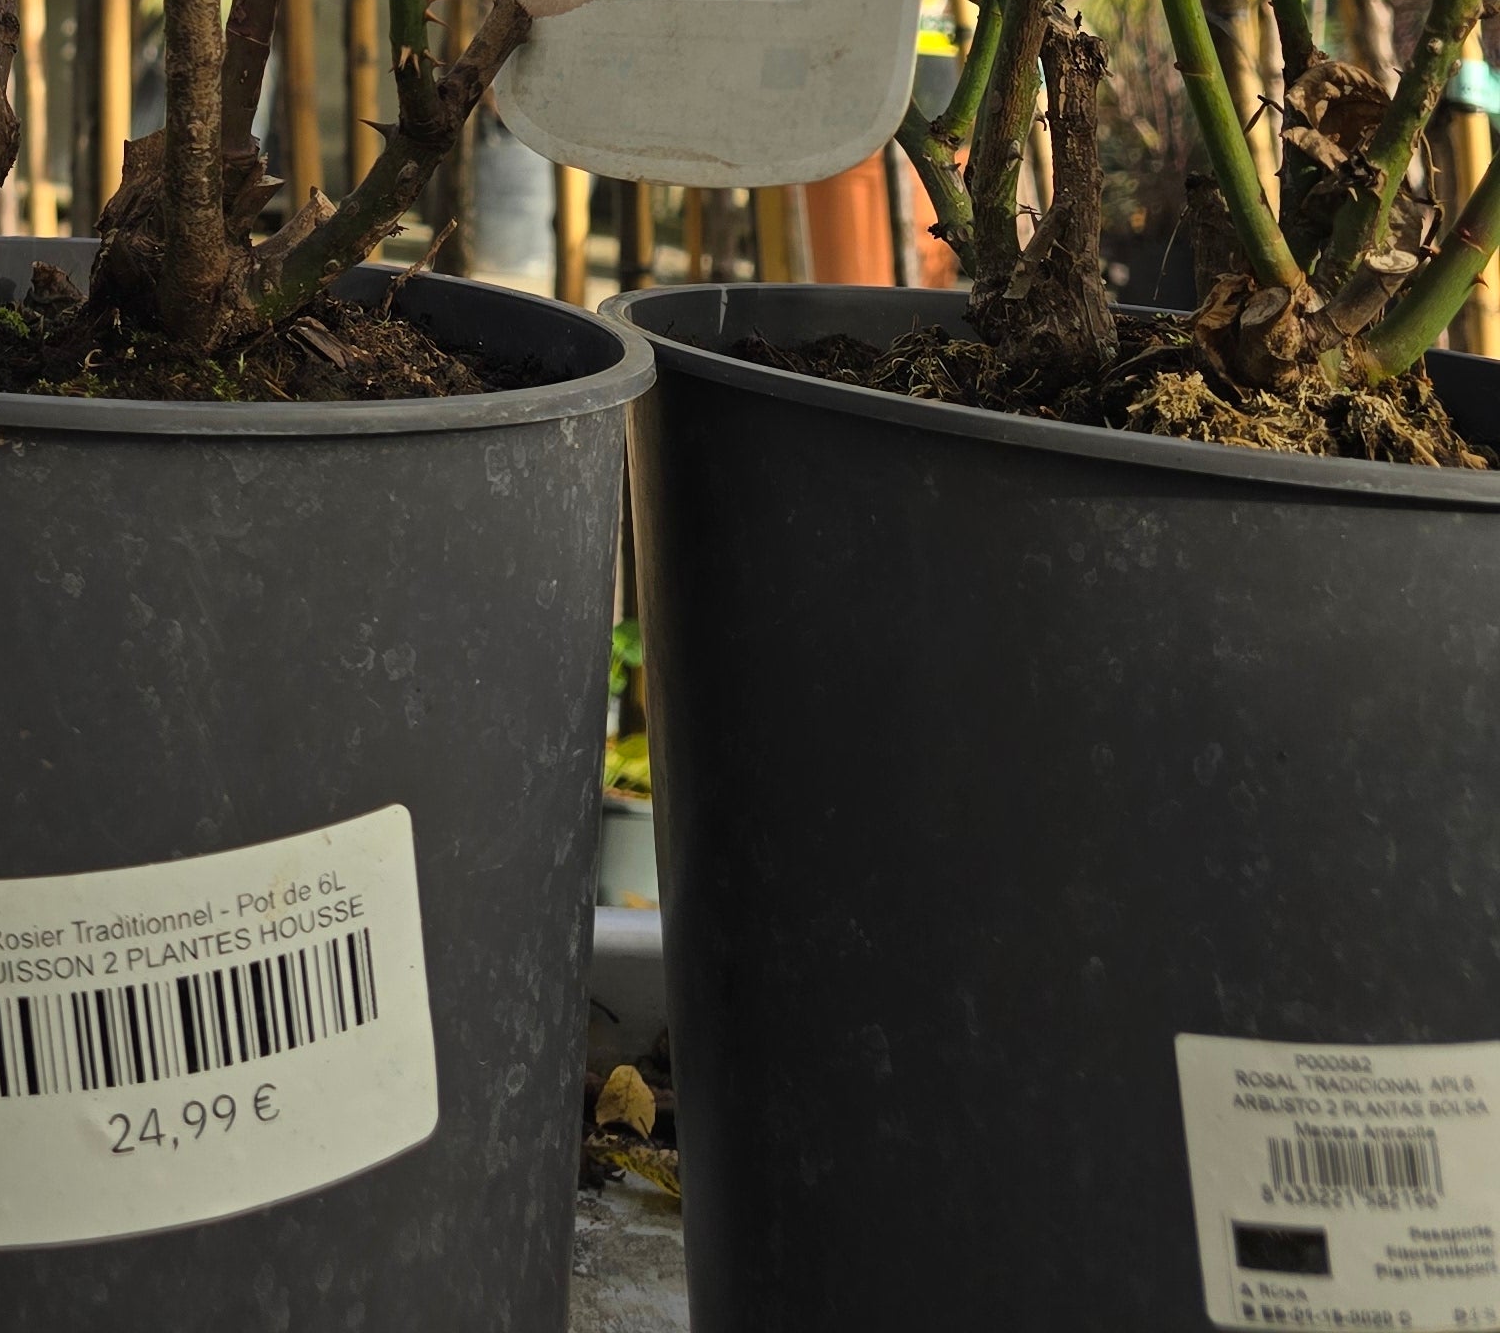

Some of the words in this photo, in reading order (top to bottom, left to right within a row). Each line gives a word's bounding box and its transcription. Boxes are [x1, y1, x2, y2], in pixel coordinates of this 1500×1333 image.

[72, 901, 213, 944] Traditionnel
[237, 889, 277, 917] Pot
[284, 882, 312, 906] de
[319, 871, 346, 894] 6L
[103, 950, 120, 975] 2
[128, 928, 252, 971] PLANTES
[260, 894, 365, 946] HOUSSE
[1233, 1093, 1323, 1115] ARBUSTO
[1327, 1099, 1338, 1116] 2
[1343, 1099, 1425, 1118] PLANTAS
[1234, 1069, 1298, 1091] ROSAL
[1303, 1074, 1424, 1095] TRADICIONAL
[108, 1094, 237, 1154] 24,99
[254, 1083, 281, 1122] €
